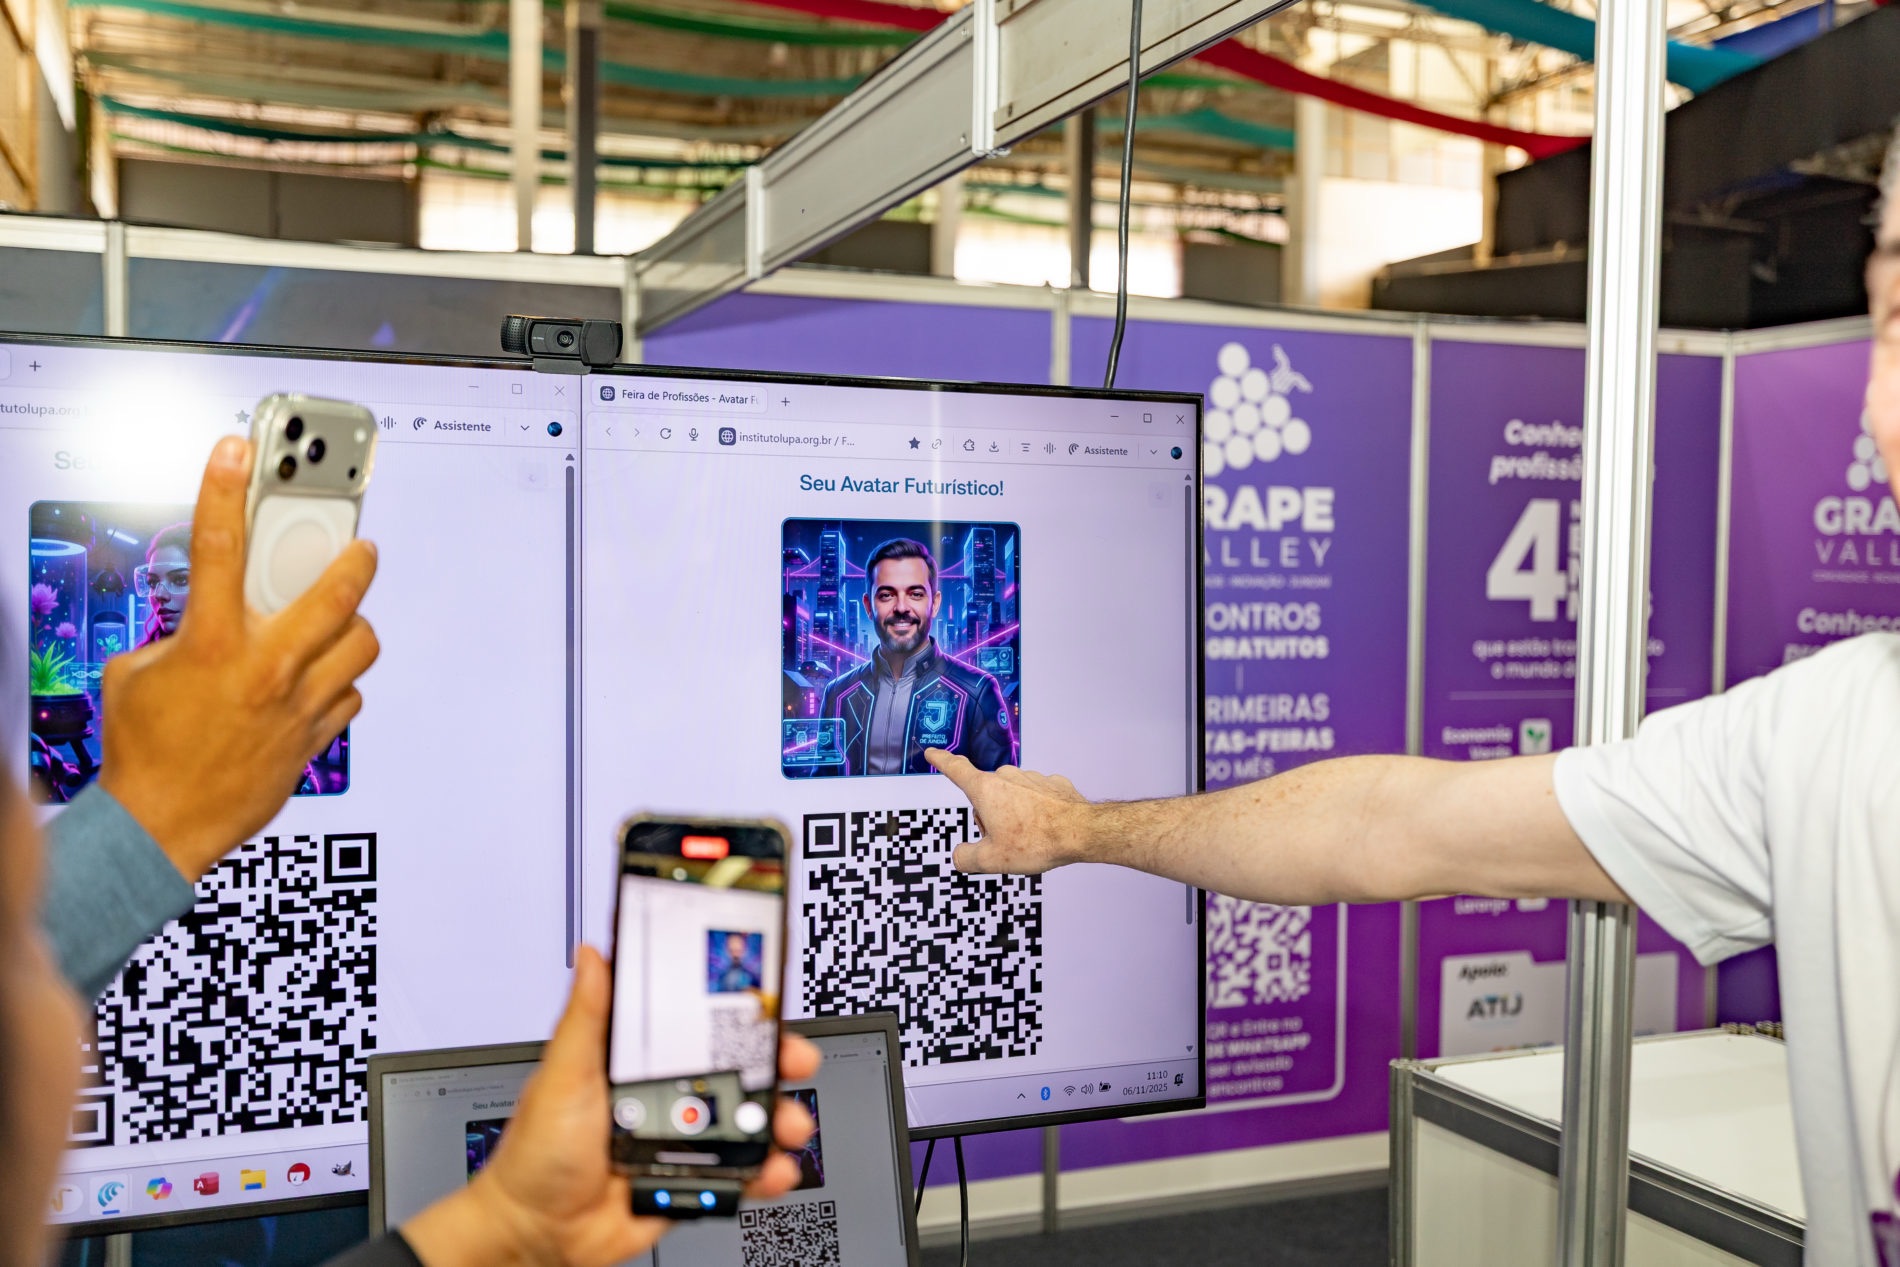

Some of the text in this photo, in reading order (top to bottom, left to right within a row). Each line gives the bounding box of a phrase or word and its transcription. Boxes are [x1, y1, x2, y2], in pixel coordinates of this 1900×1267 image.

[622, 389, 645, 400] Feira
[647, 390, 660, 400] de
[662, 391, 710, 403] Profissões
[718, 394, 748, 404] Avatar
[434, 420, 492, 432] Assistente
[739, 432, 832, 447] institutolupa.org.br
[1084, 446, 1128, 456] Assistente
[800, 474, 1004, 496] Seu Avatar Futurístico!
[1485, 498, 1569, 621] 4
[1206, 636, 1329, 660] GRATUITOS
[1147, 1071, 1168, 1080] 11:10
[1123, 1083, 1168, 1096] 06/11/2025
